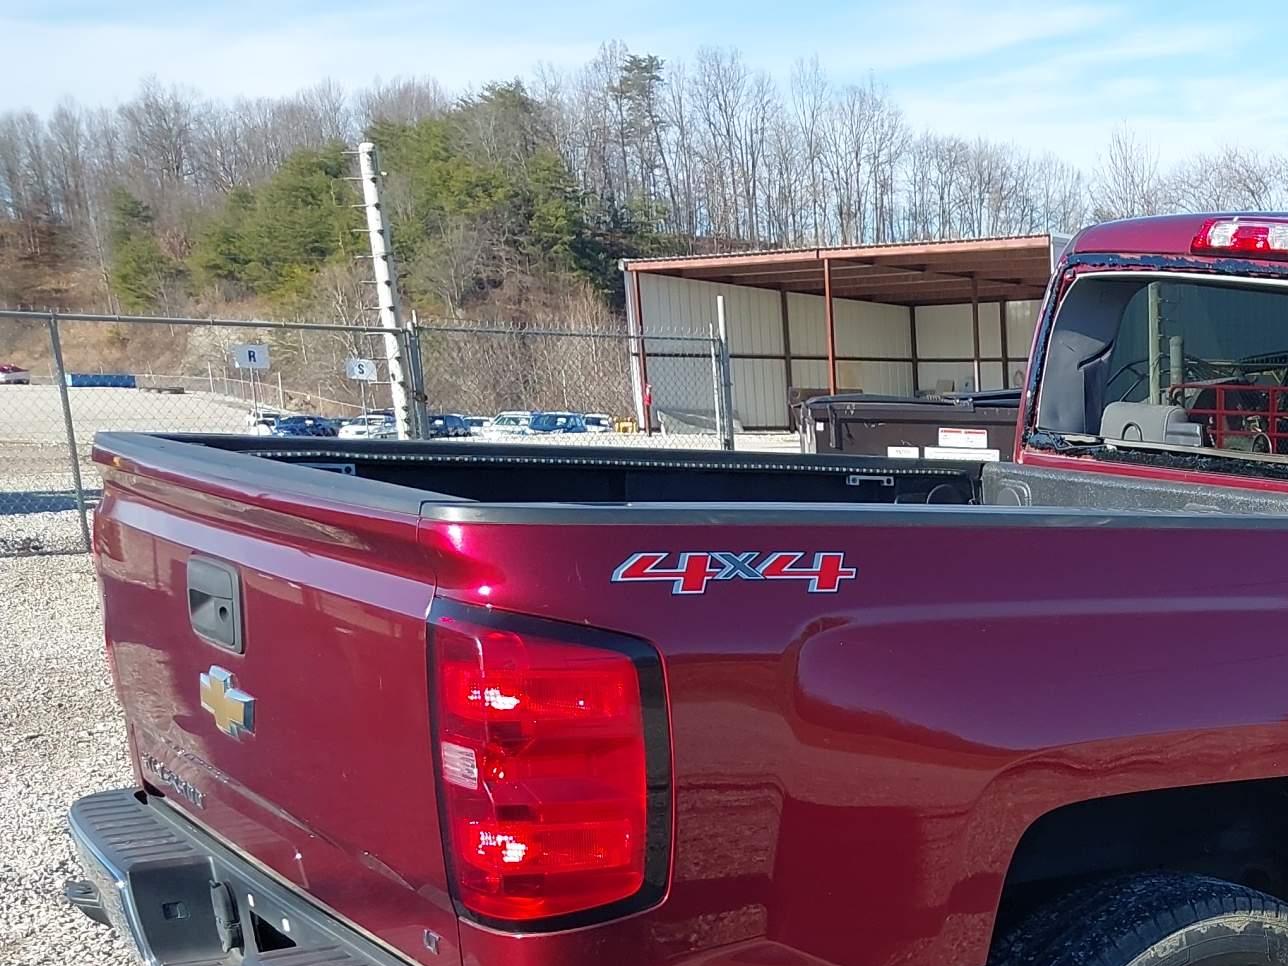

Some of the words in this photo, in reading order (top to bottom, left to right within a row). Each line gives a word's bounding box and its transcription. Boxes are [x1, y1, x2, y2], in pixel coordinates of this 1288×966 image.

[247, 350, 257, 363] R
[357, 363, 365, 375] S
[423, 928, 440, 955] LT
